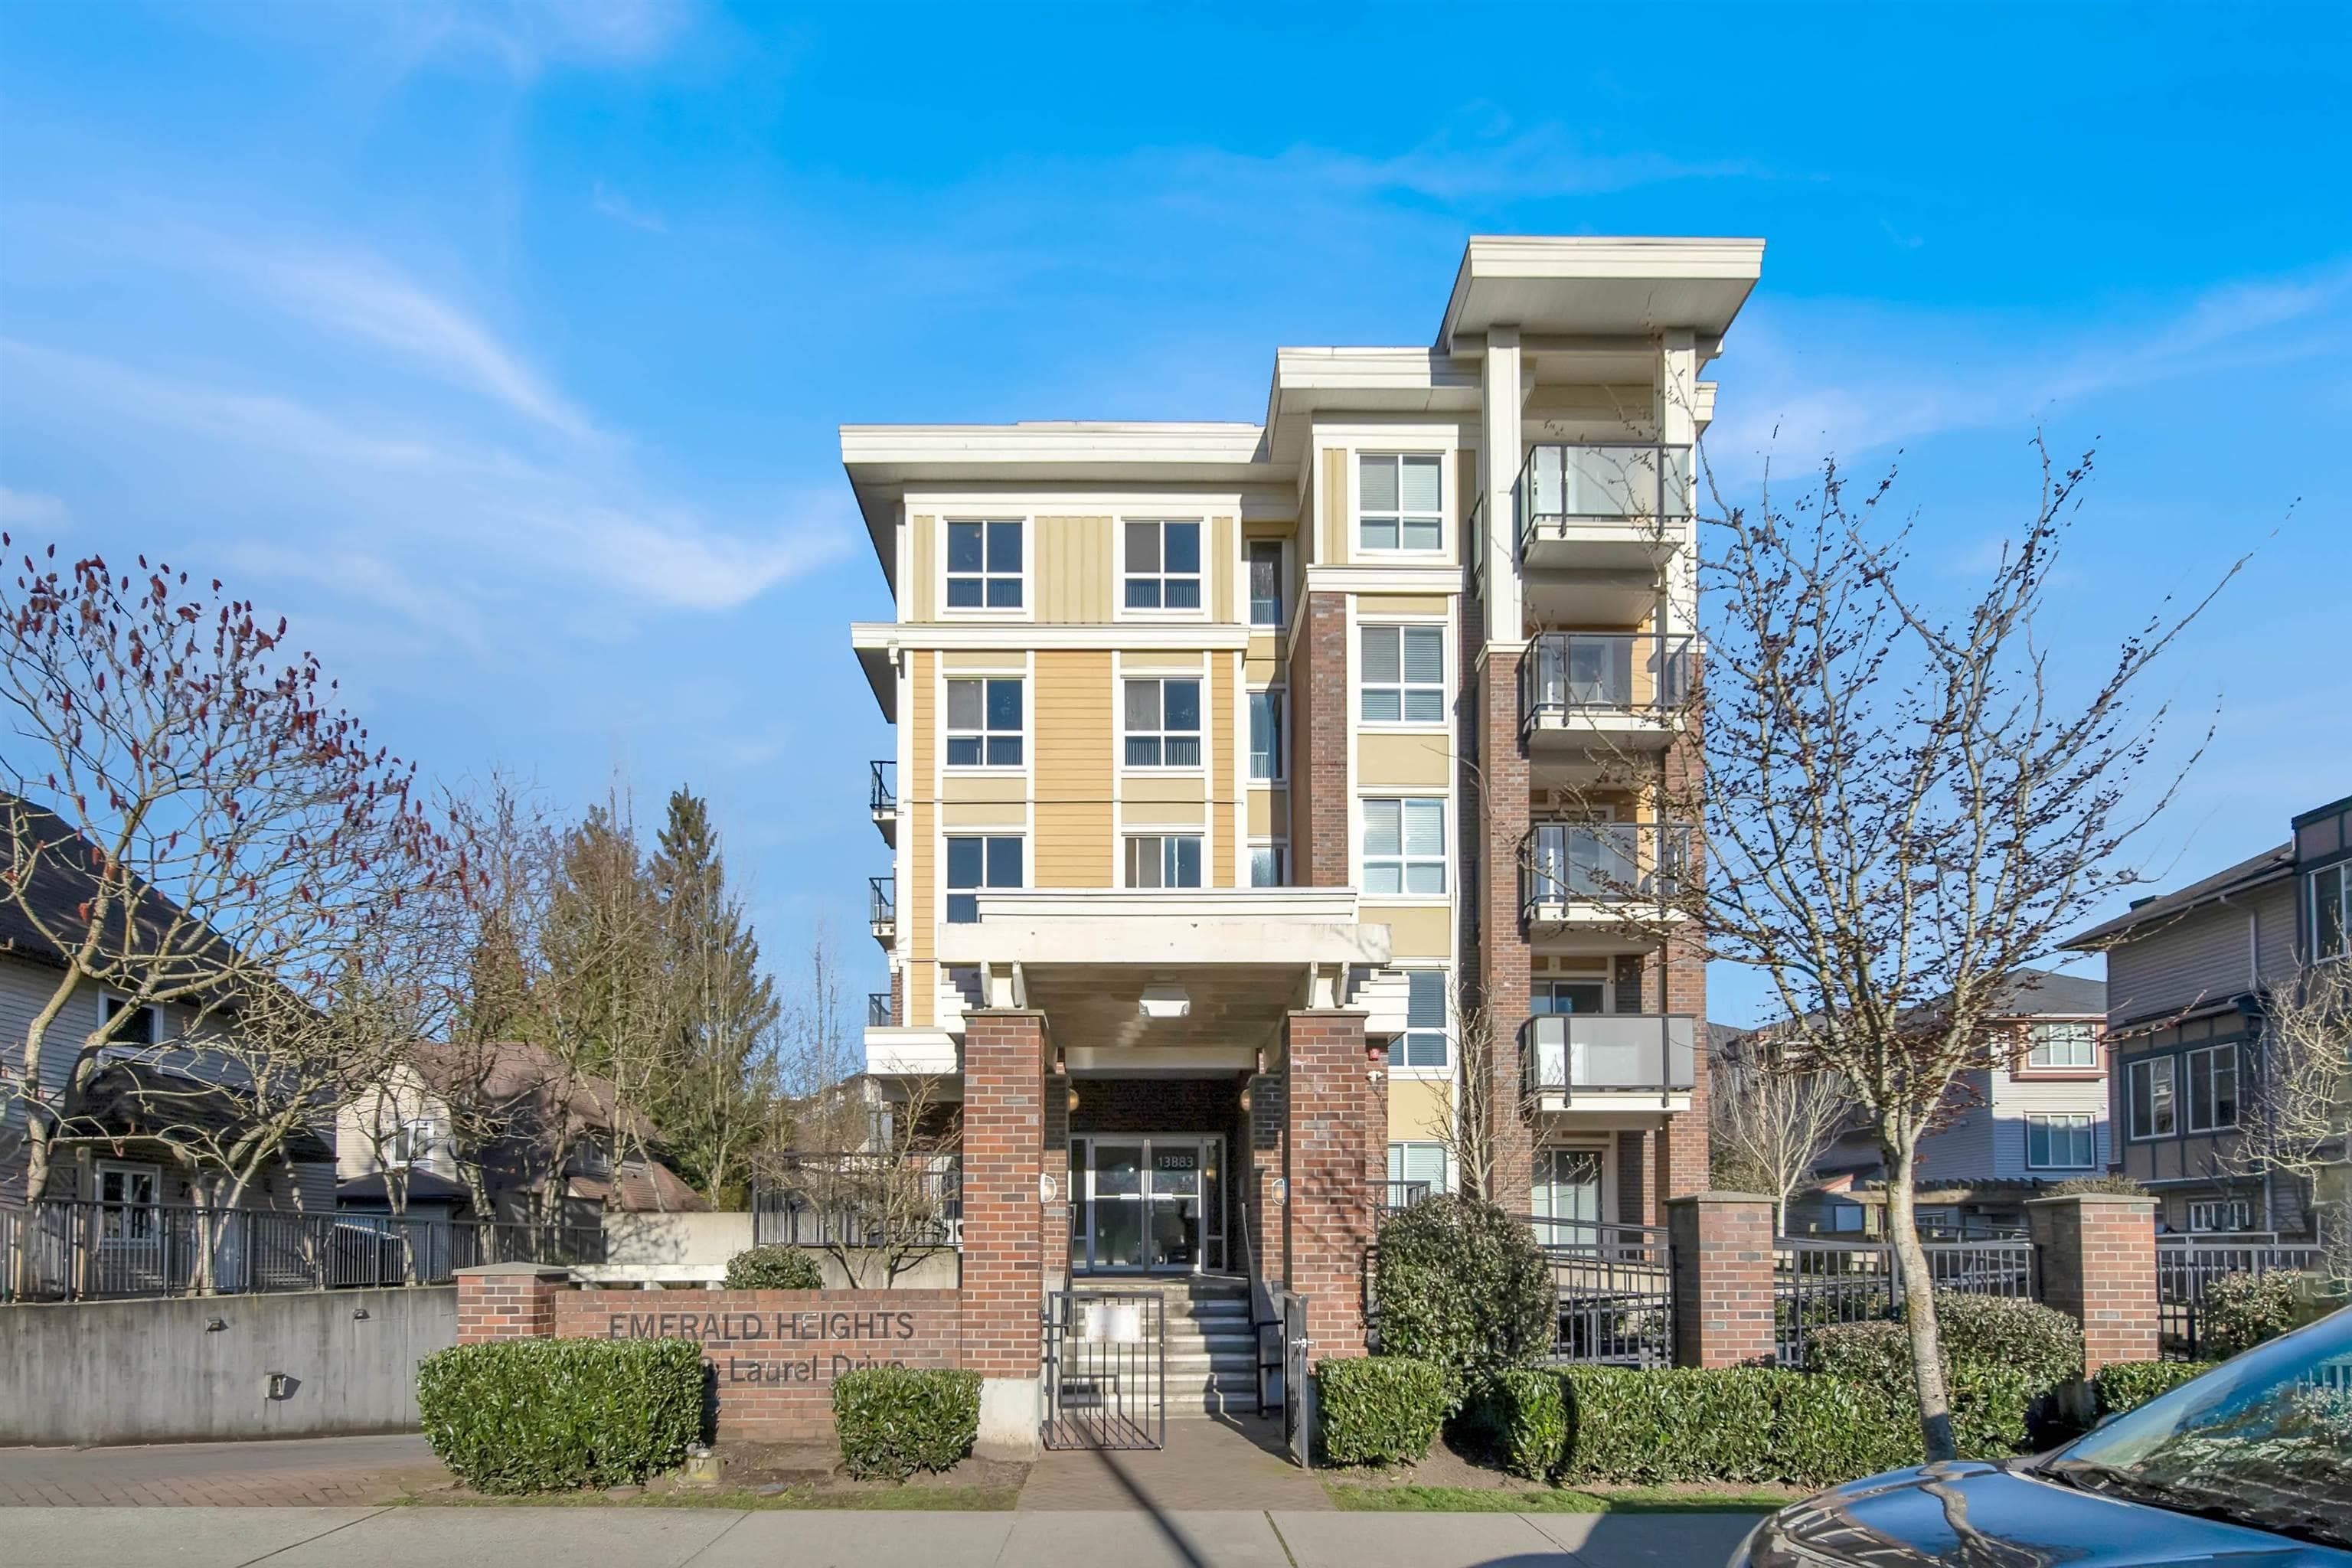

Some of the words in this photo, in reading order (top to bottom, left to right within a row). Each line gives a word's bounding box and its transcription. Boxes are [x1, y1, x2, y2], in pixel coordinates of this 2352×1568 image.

[1158, 1156, 1194, 1168] 13883
[609, 1313, 762, 1340] EMERALD
[777, 1312, 914, 1340] HEIGHTS
[730, 1355, 817, 1383] Laurel
